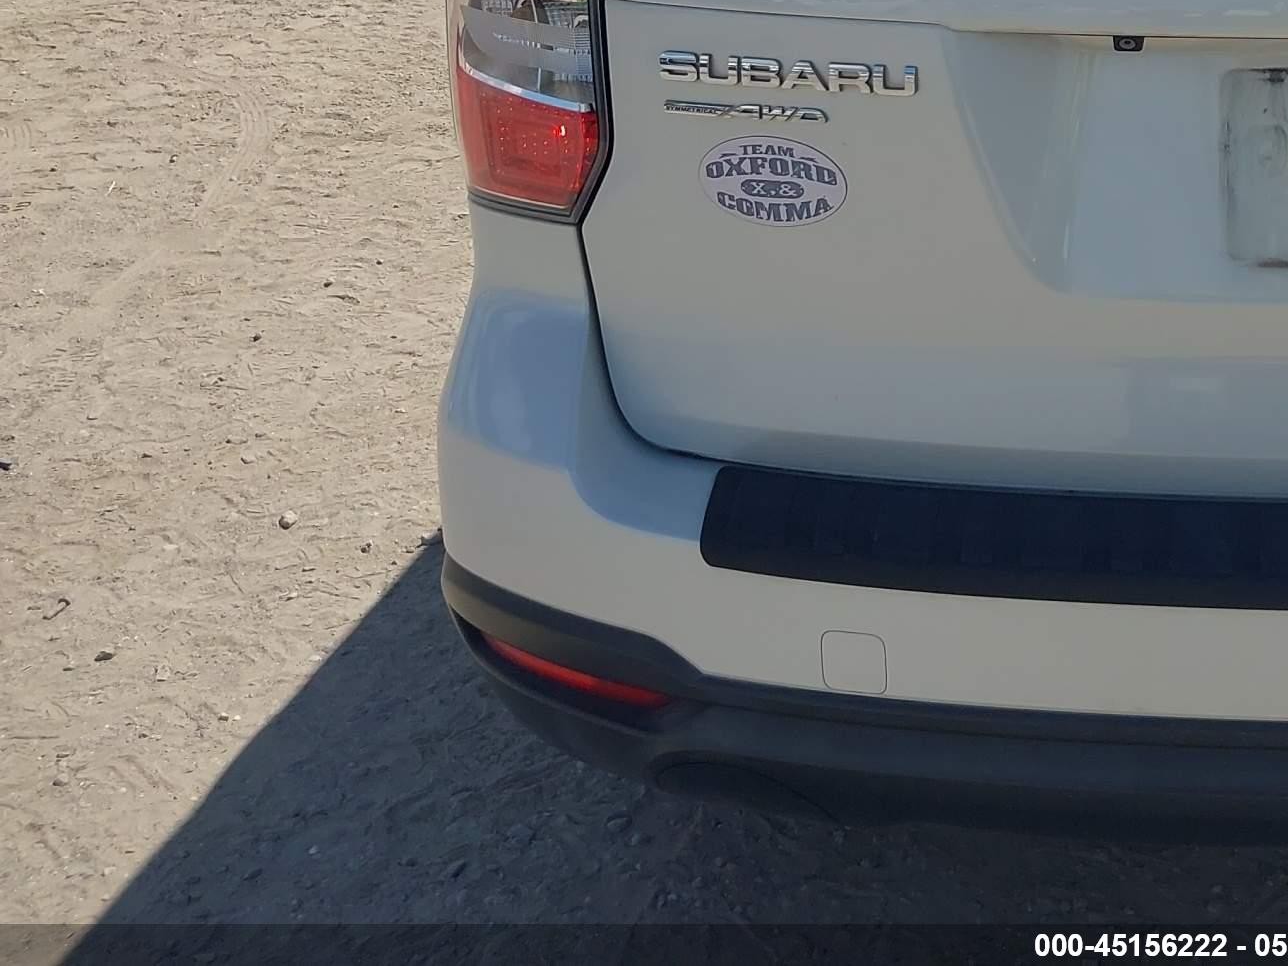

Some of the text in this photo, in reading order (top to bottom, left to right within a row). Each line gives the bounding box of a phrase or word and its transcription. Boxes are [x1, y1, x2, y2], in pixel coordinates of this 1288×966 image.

[658, 50, 919, 96] SUBARU
[733, 103, 829, 124] AWD
[739, 144, 796, 158] TEAM
[705, 157, 838, 185] OXFORD
[716, 192, 835, 222] COMMA
